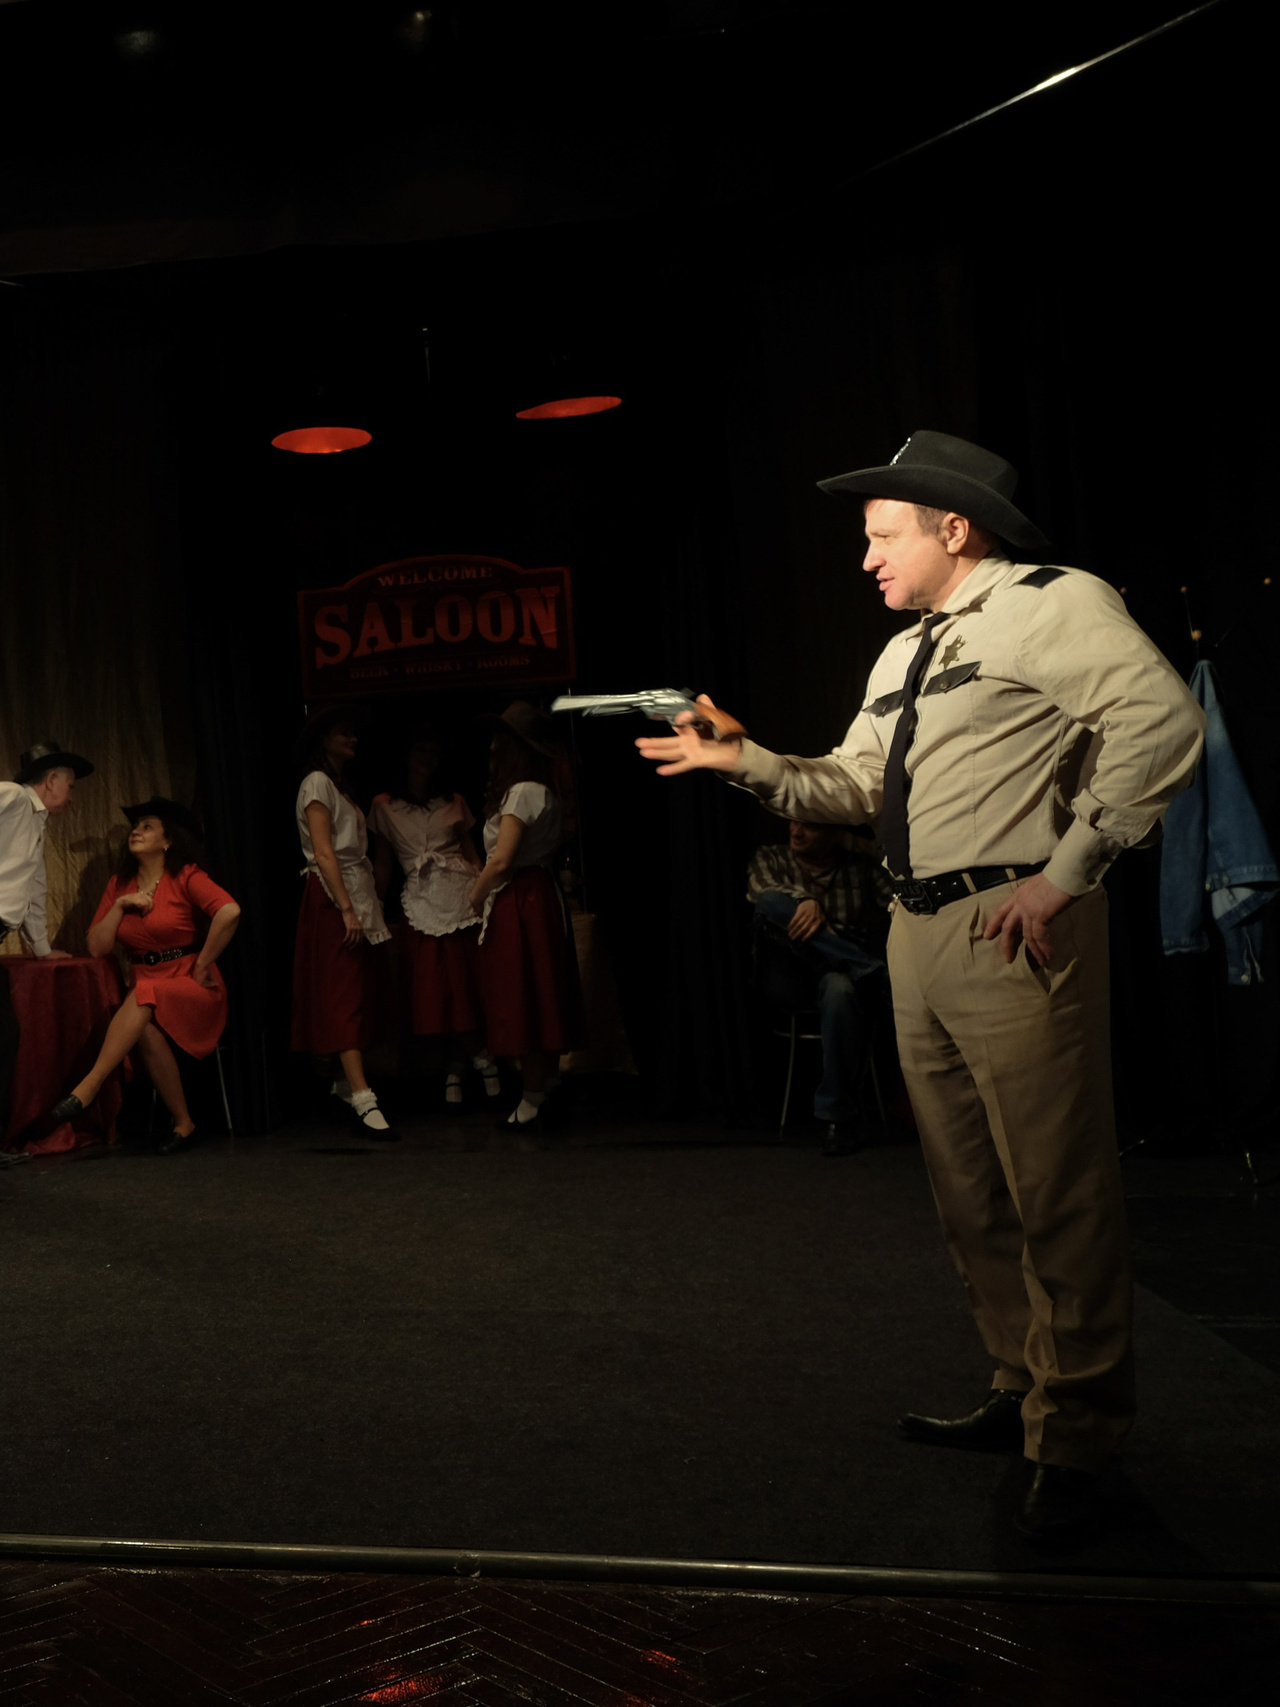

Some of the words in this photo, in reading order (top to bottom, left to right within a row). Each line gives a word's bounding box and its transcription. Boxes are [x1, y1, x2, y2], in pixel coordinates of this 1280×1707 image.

[376, 565, 494, 588] WELCOME
[313, 584, 561, 670] SALOON
[476, 652, 531, 669] ROOMS
